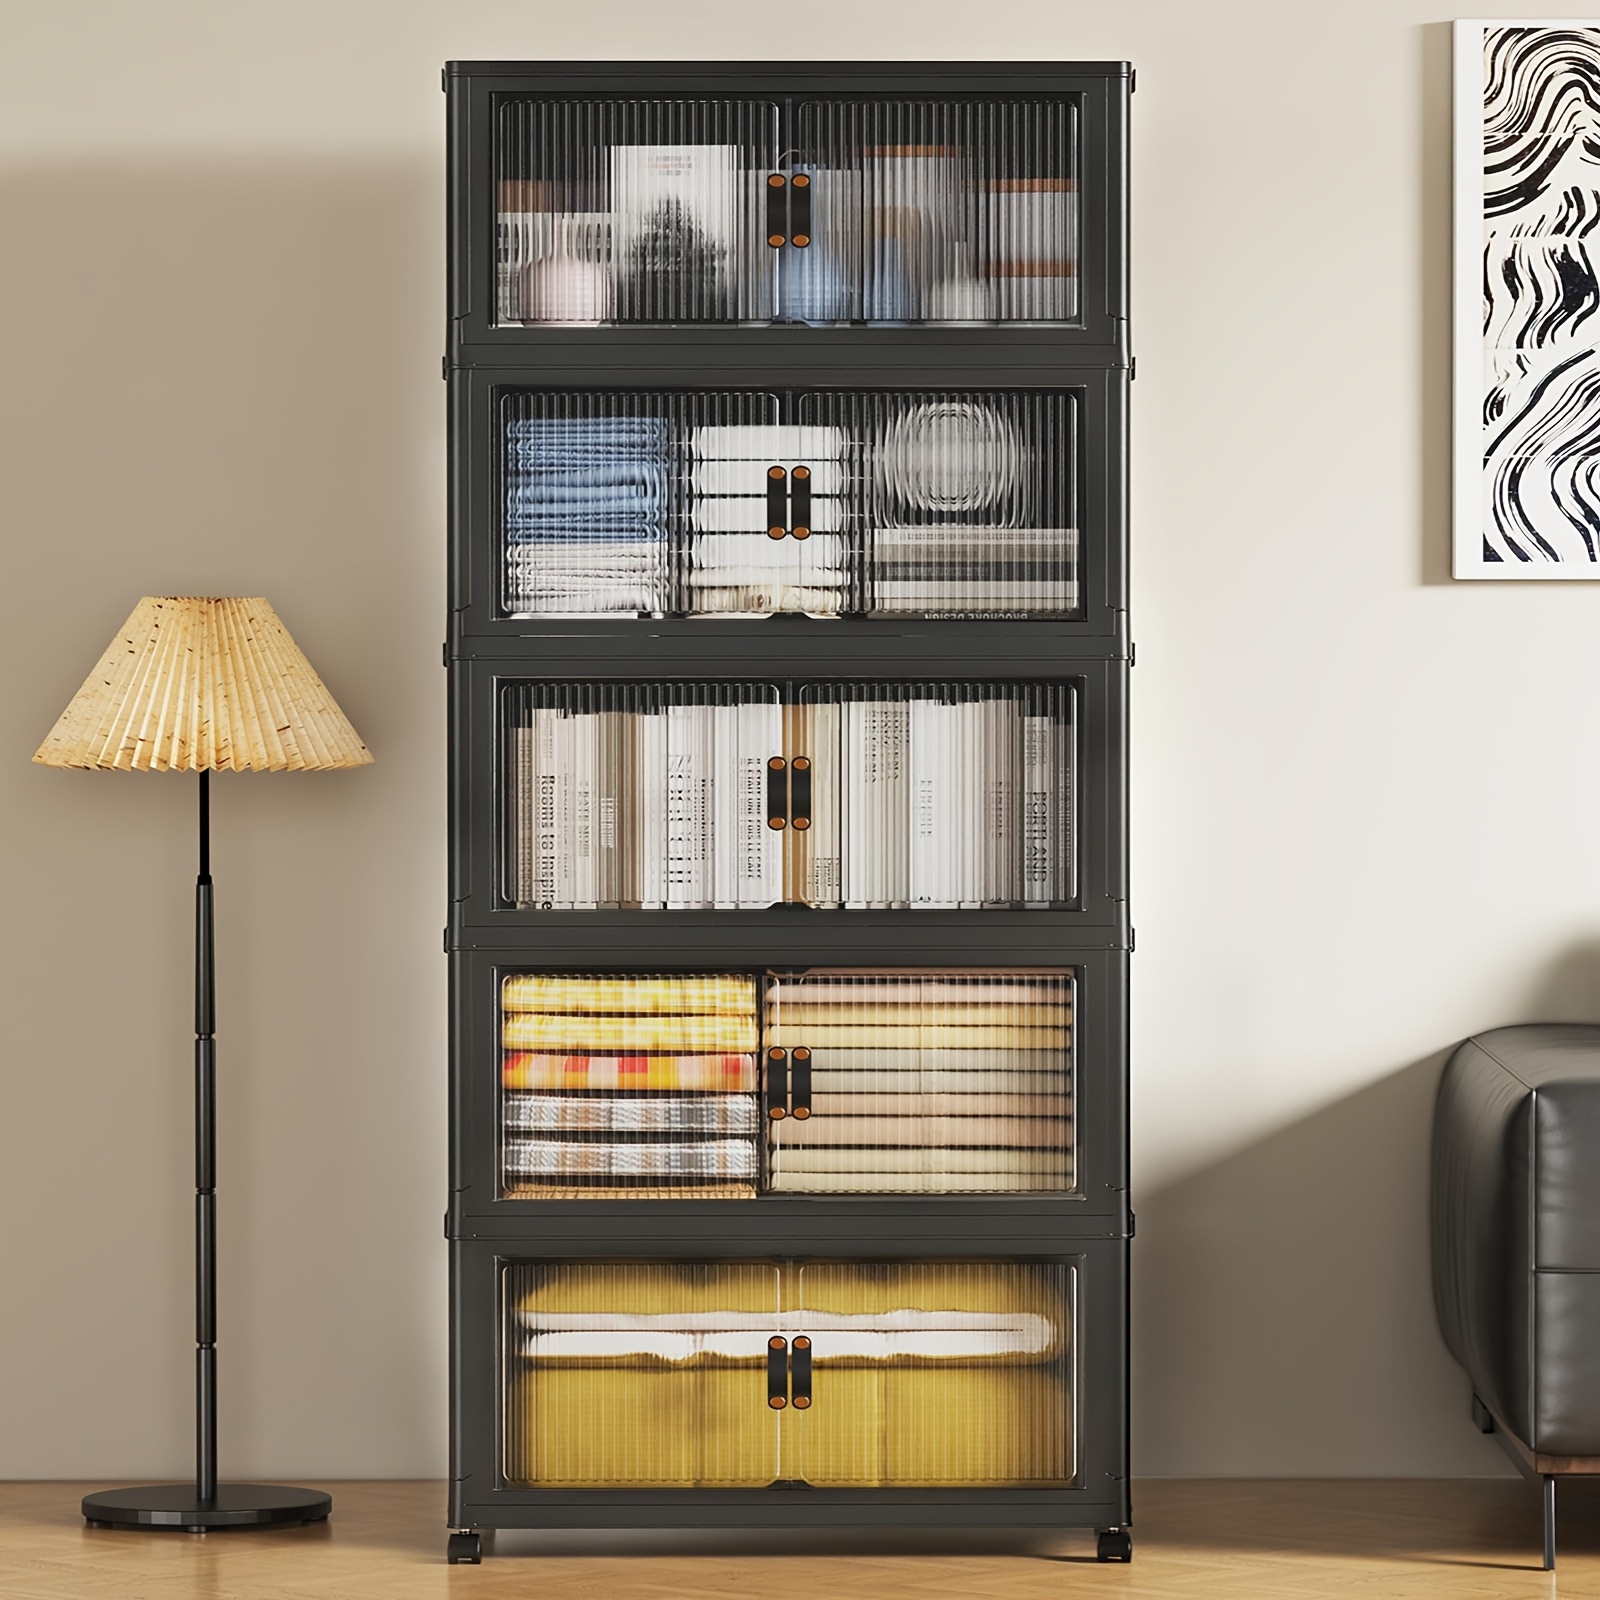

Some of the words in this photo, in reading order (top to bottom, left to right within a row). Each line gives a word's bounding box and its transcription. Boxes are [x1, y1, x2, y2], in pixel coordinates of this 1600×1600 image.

[540, 775, 556, 829] Rooms
[540, 834, 556, 850] to
[1030, 791, 1048, 883] PORTLAND
[535, 856, 556, 910] Inspire
